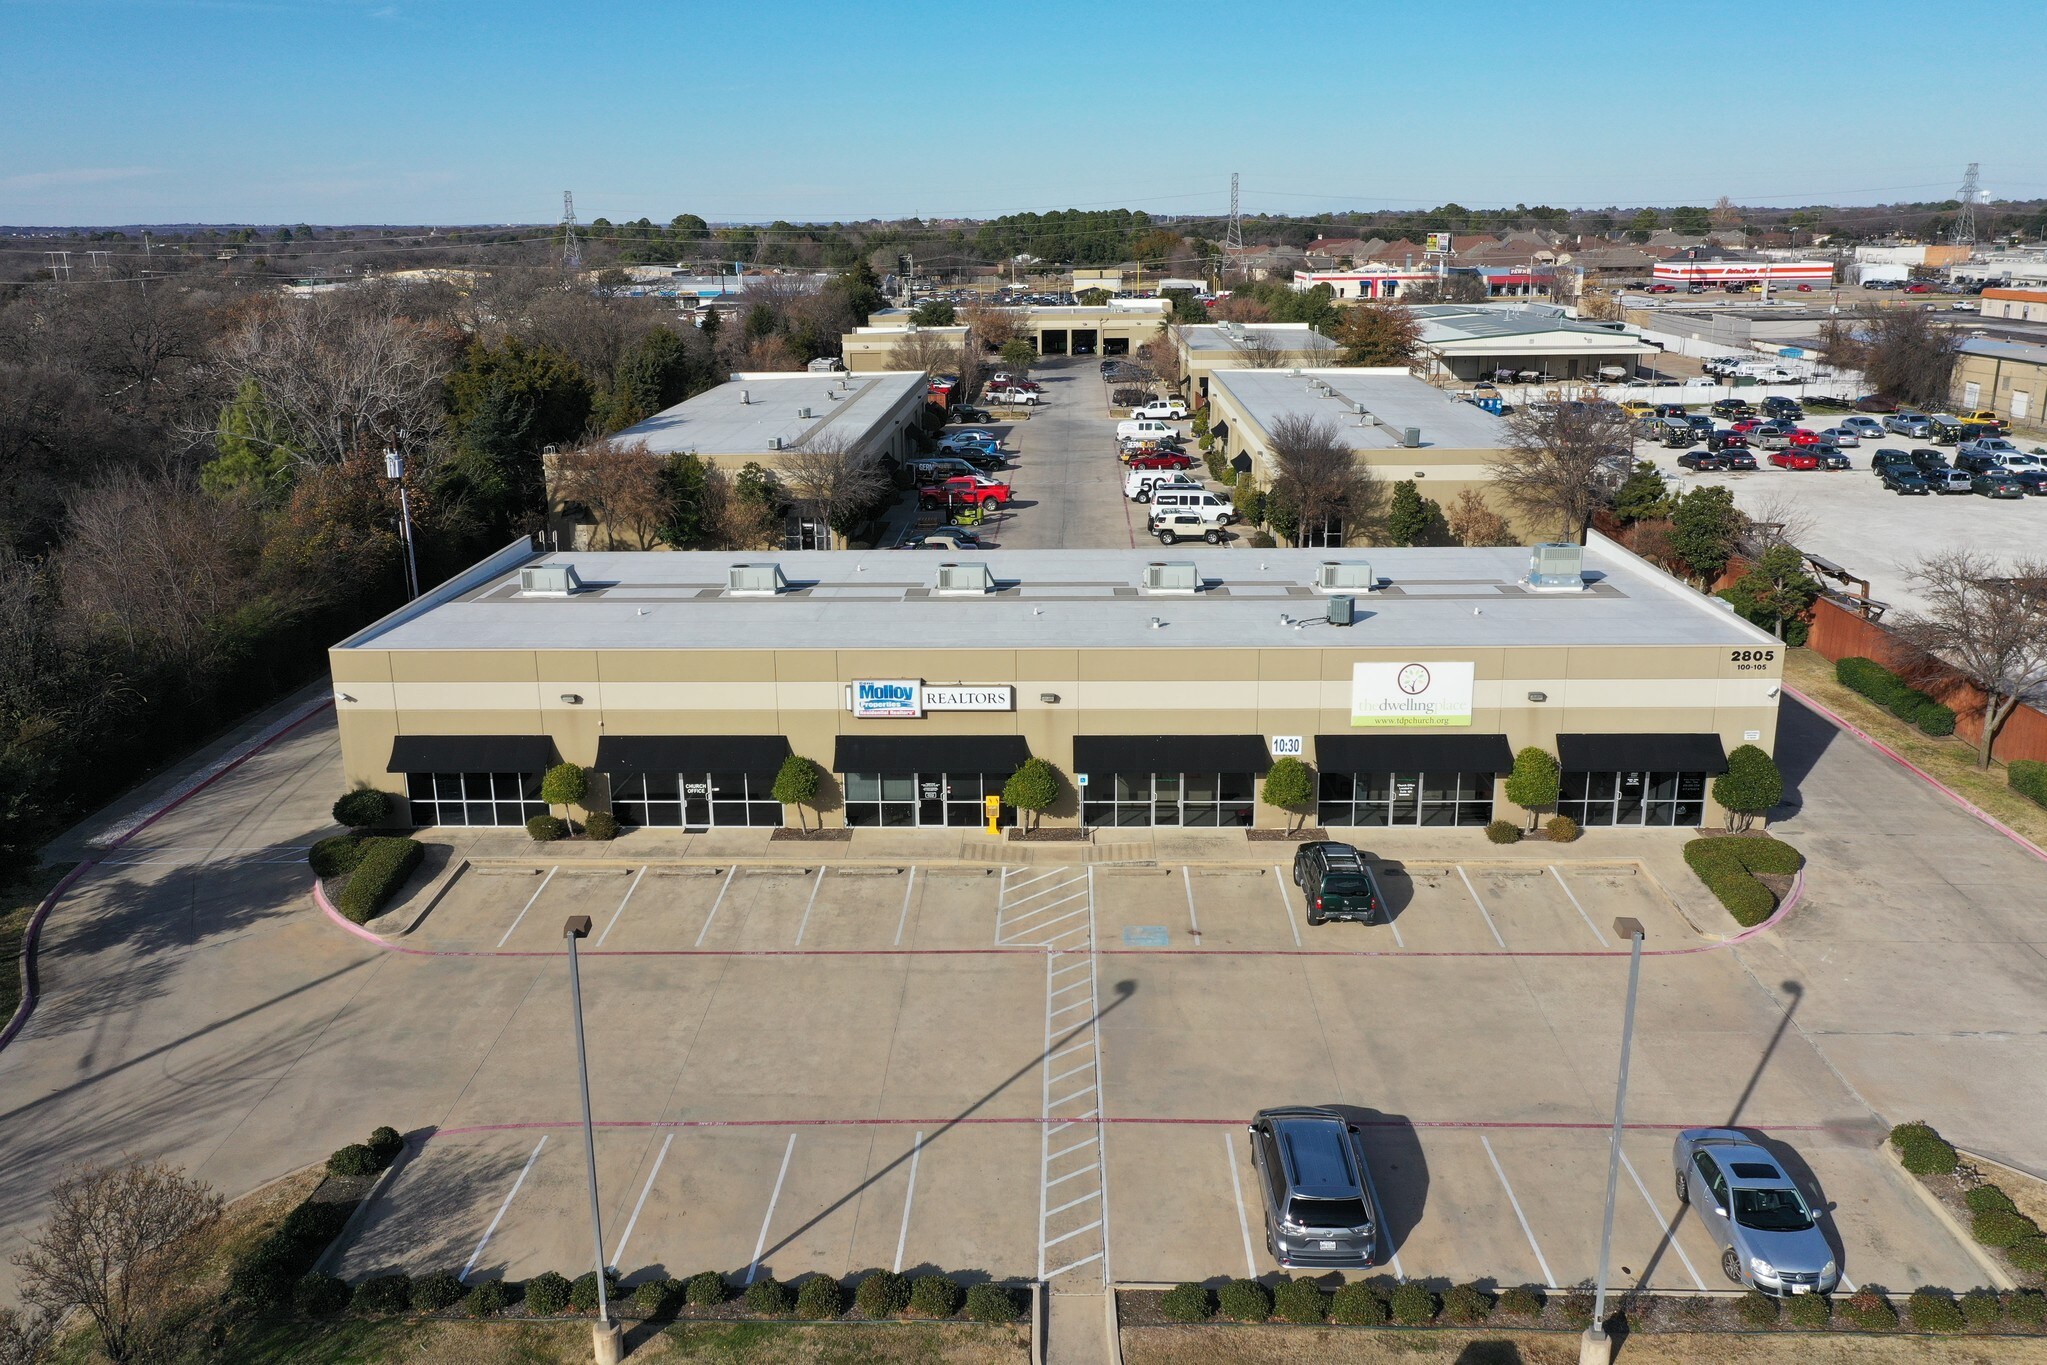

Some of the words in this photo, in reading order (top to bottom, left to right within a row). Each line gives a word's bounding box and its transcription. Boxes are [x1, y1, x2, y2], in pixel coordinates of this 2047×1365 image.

[1731, 651, 1774, 661] 2805
[859, 685, 913, 700] Molloy
[927, 693, 1006, 704] REALTORS
[1375, 717, 1449, 725] www.tdpchurch.org
[1274, 739, 1299, 752] 10:30
